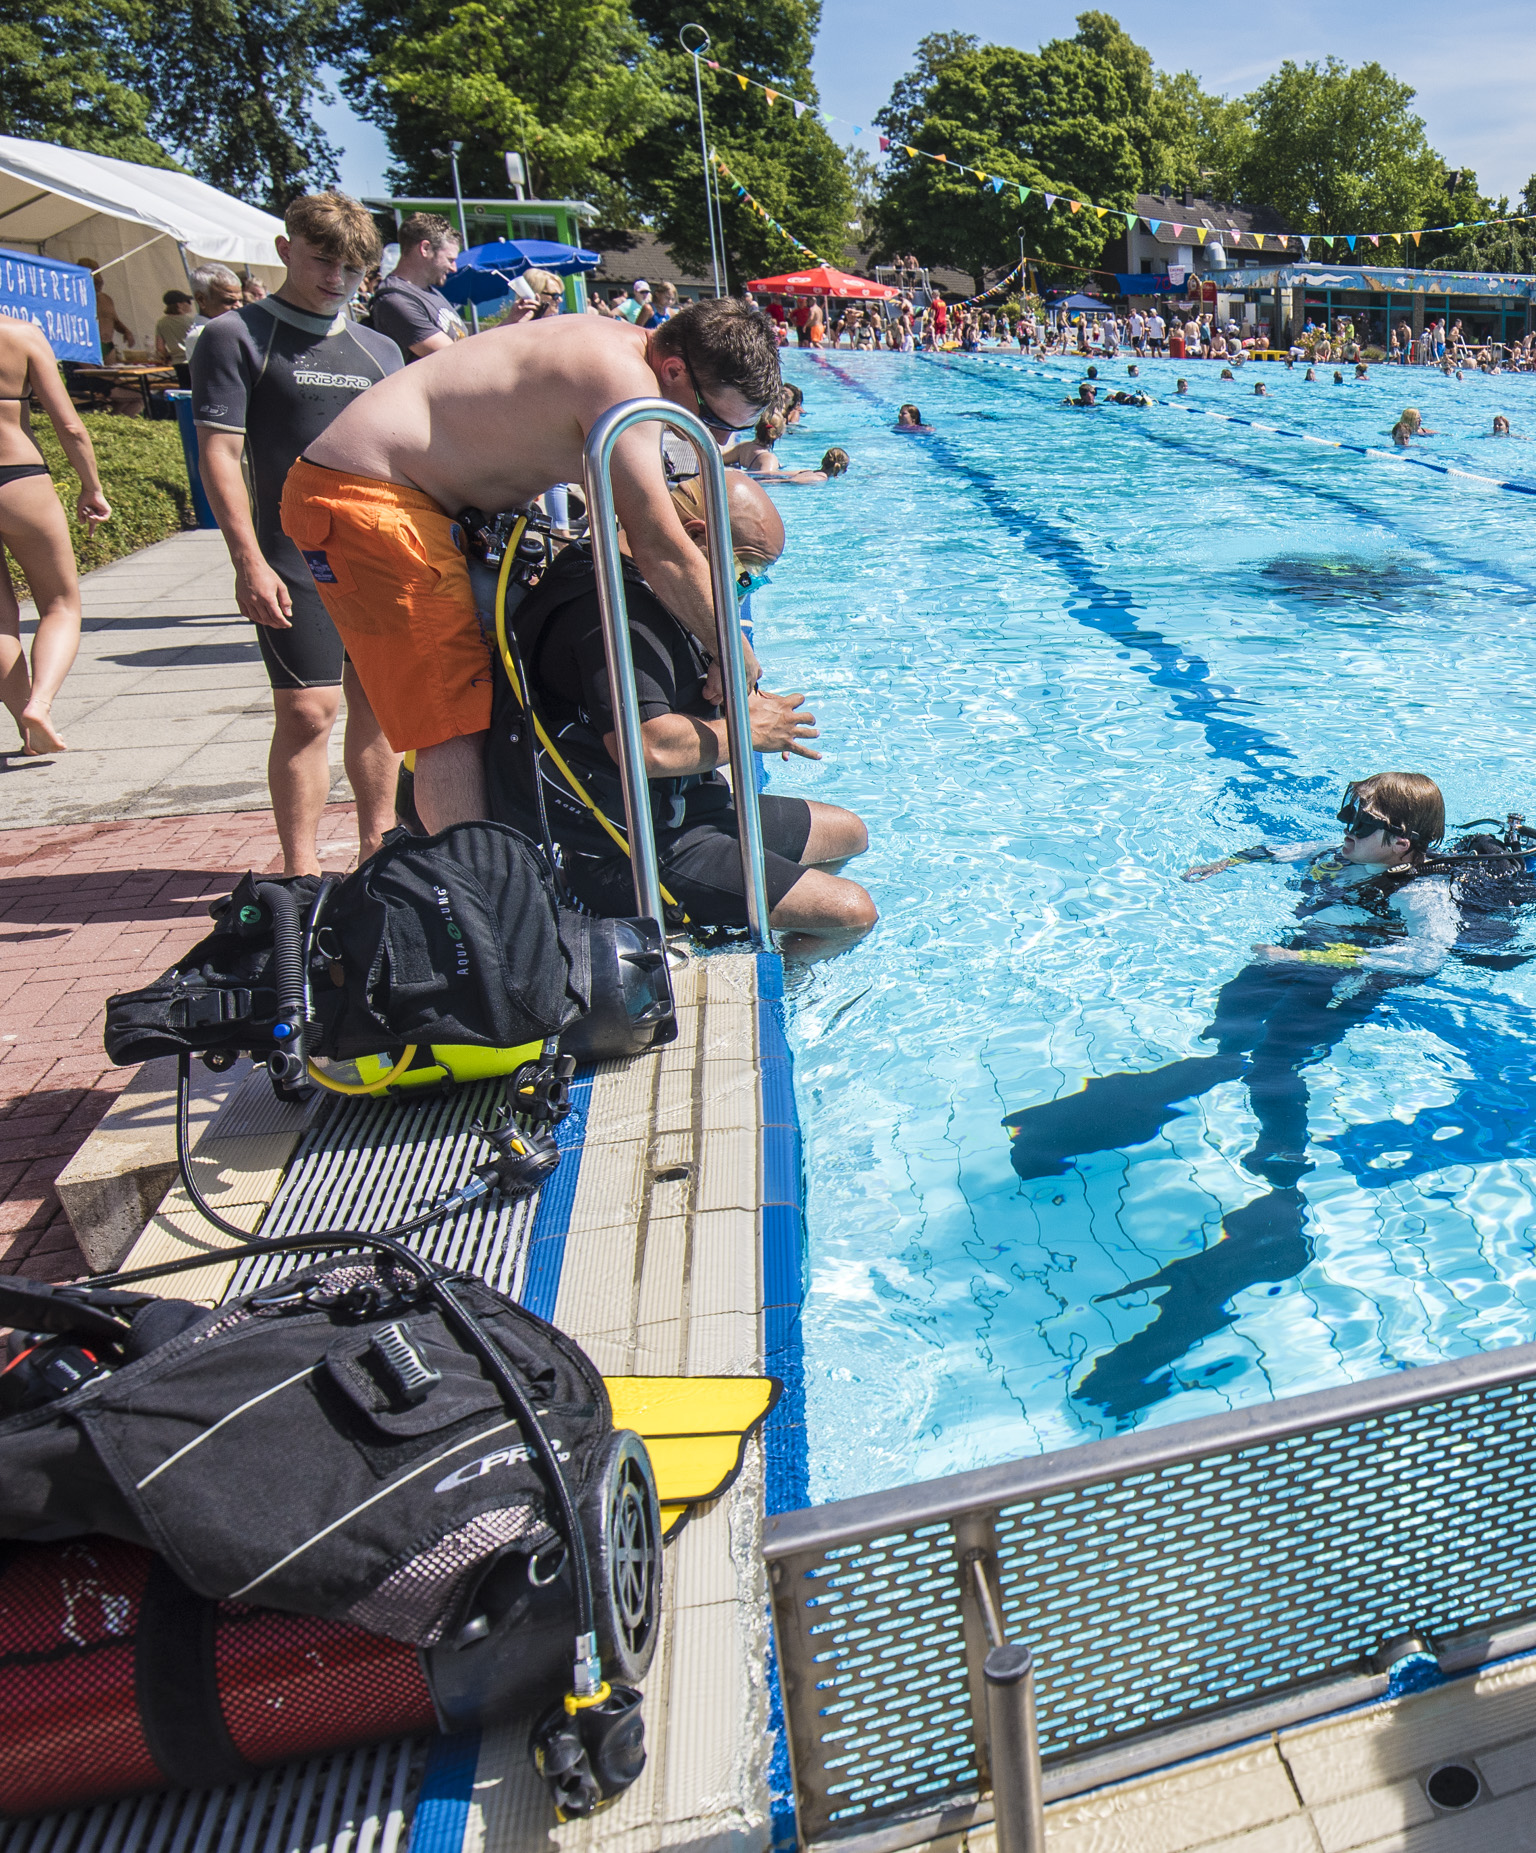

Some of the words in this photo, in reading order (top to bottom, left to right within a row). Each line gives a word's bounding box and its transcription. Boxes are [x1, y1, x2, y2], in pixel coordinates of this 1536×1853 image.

[0, 260, 88, 308] CHVEREIN
[1153, 276, 1172, 290] 70
[46, 310, 93, 348] RAUXEL
[454, 942, 470, 975] AQUA
